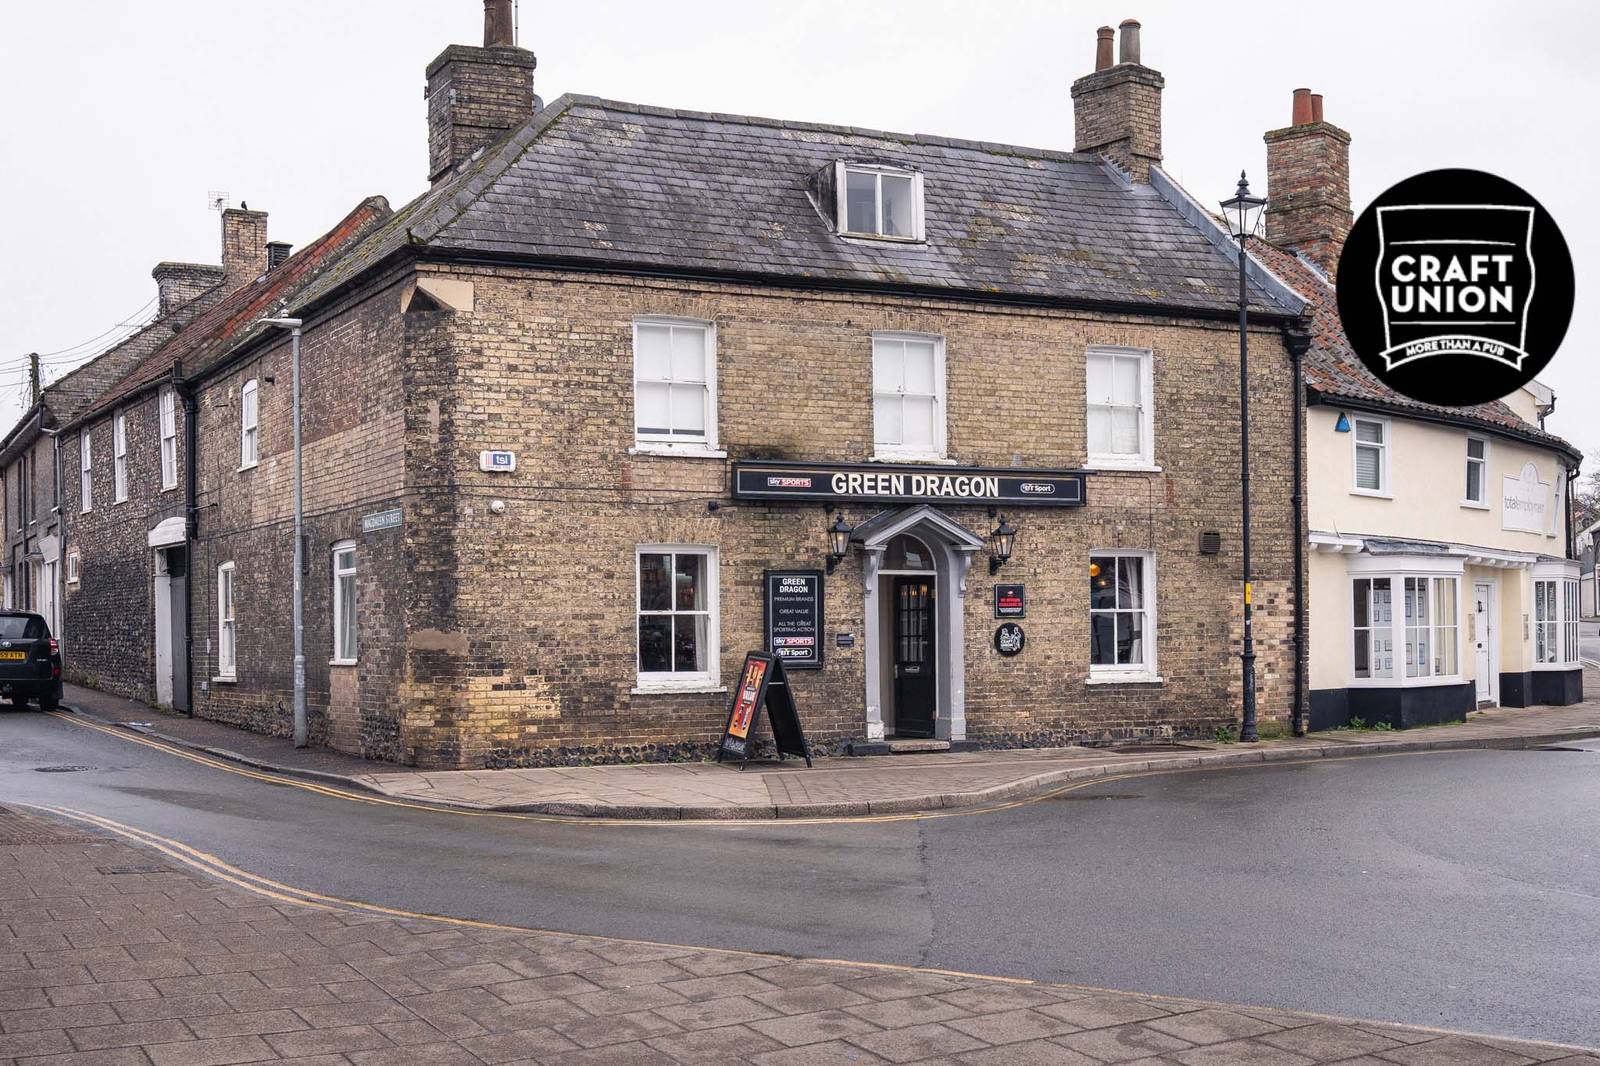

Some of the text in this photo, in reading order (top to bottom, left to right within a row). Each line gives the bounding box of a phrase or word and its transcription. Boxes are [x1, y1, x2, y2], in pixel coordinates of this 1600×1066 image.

[769, 479, 810, 487] sky SPORTS
[831, 472, 999, 497] GREEN DRAGON
[1035, 484, 1051, 493] Sport
[775, 637, 786, 646] sky
[791, 649, 809, 657] Sport
